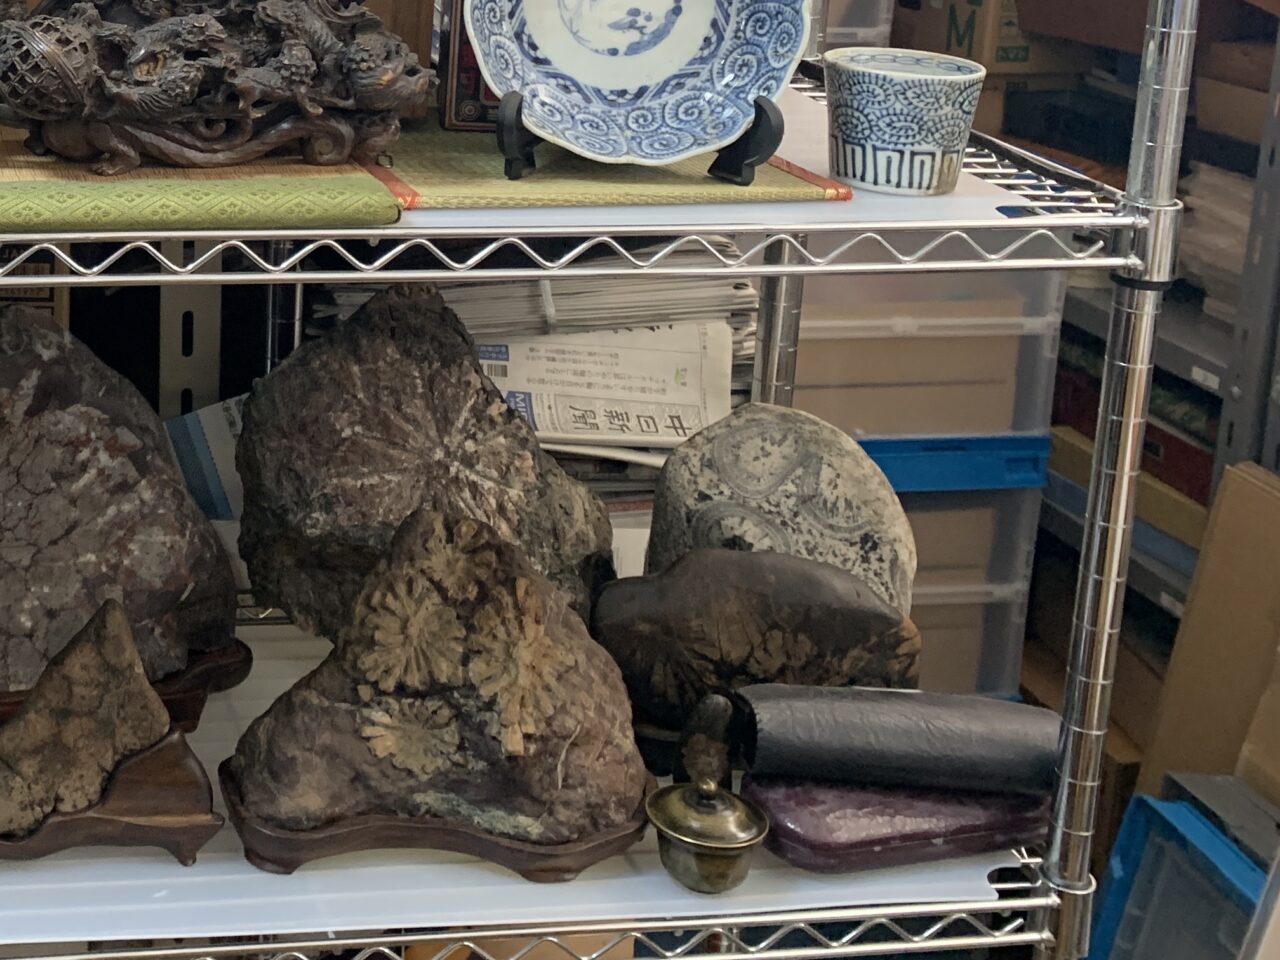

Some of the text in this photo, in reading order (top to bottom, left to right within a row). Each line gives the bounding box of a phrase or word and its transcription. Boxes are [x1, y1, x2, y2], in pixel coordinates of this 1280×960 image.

[946, 3, 976, 57] M
[570, 405, 693, 438] 中日新聞
